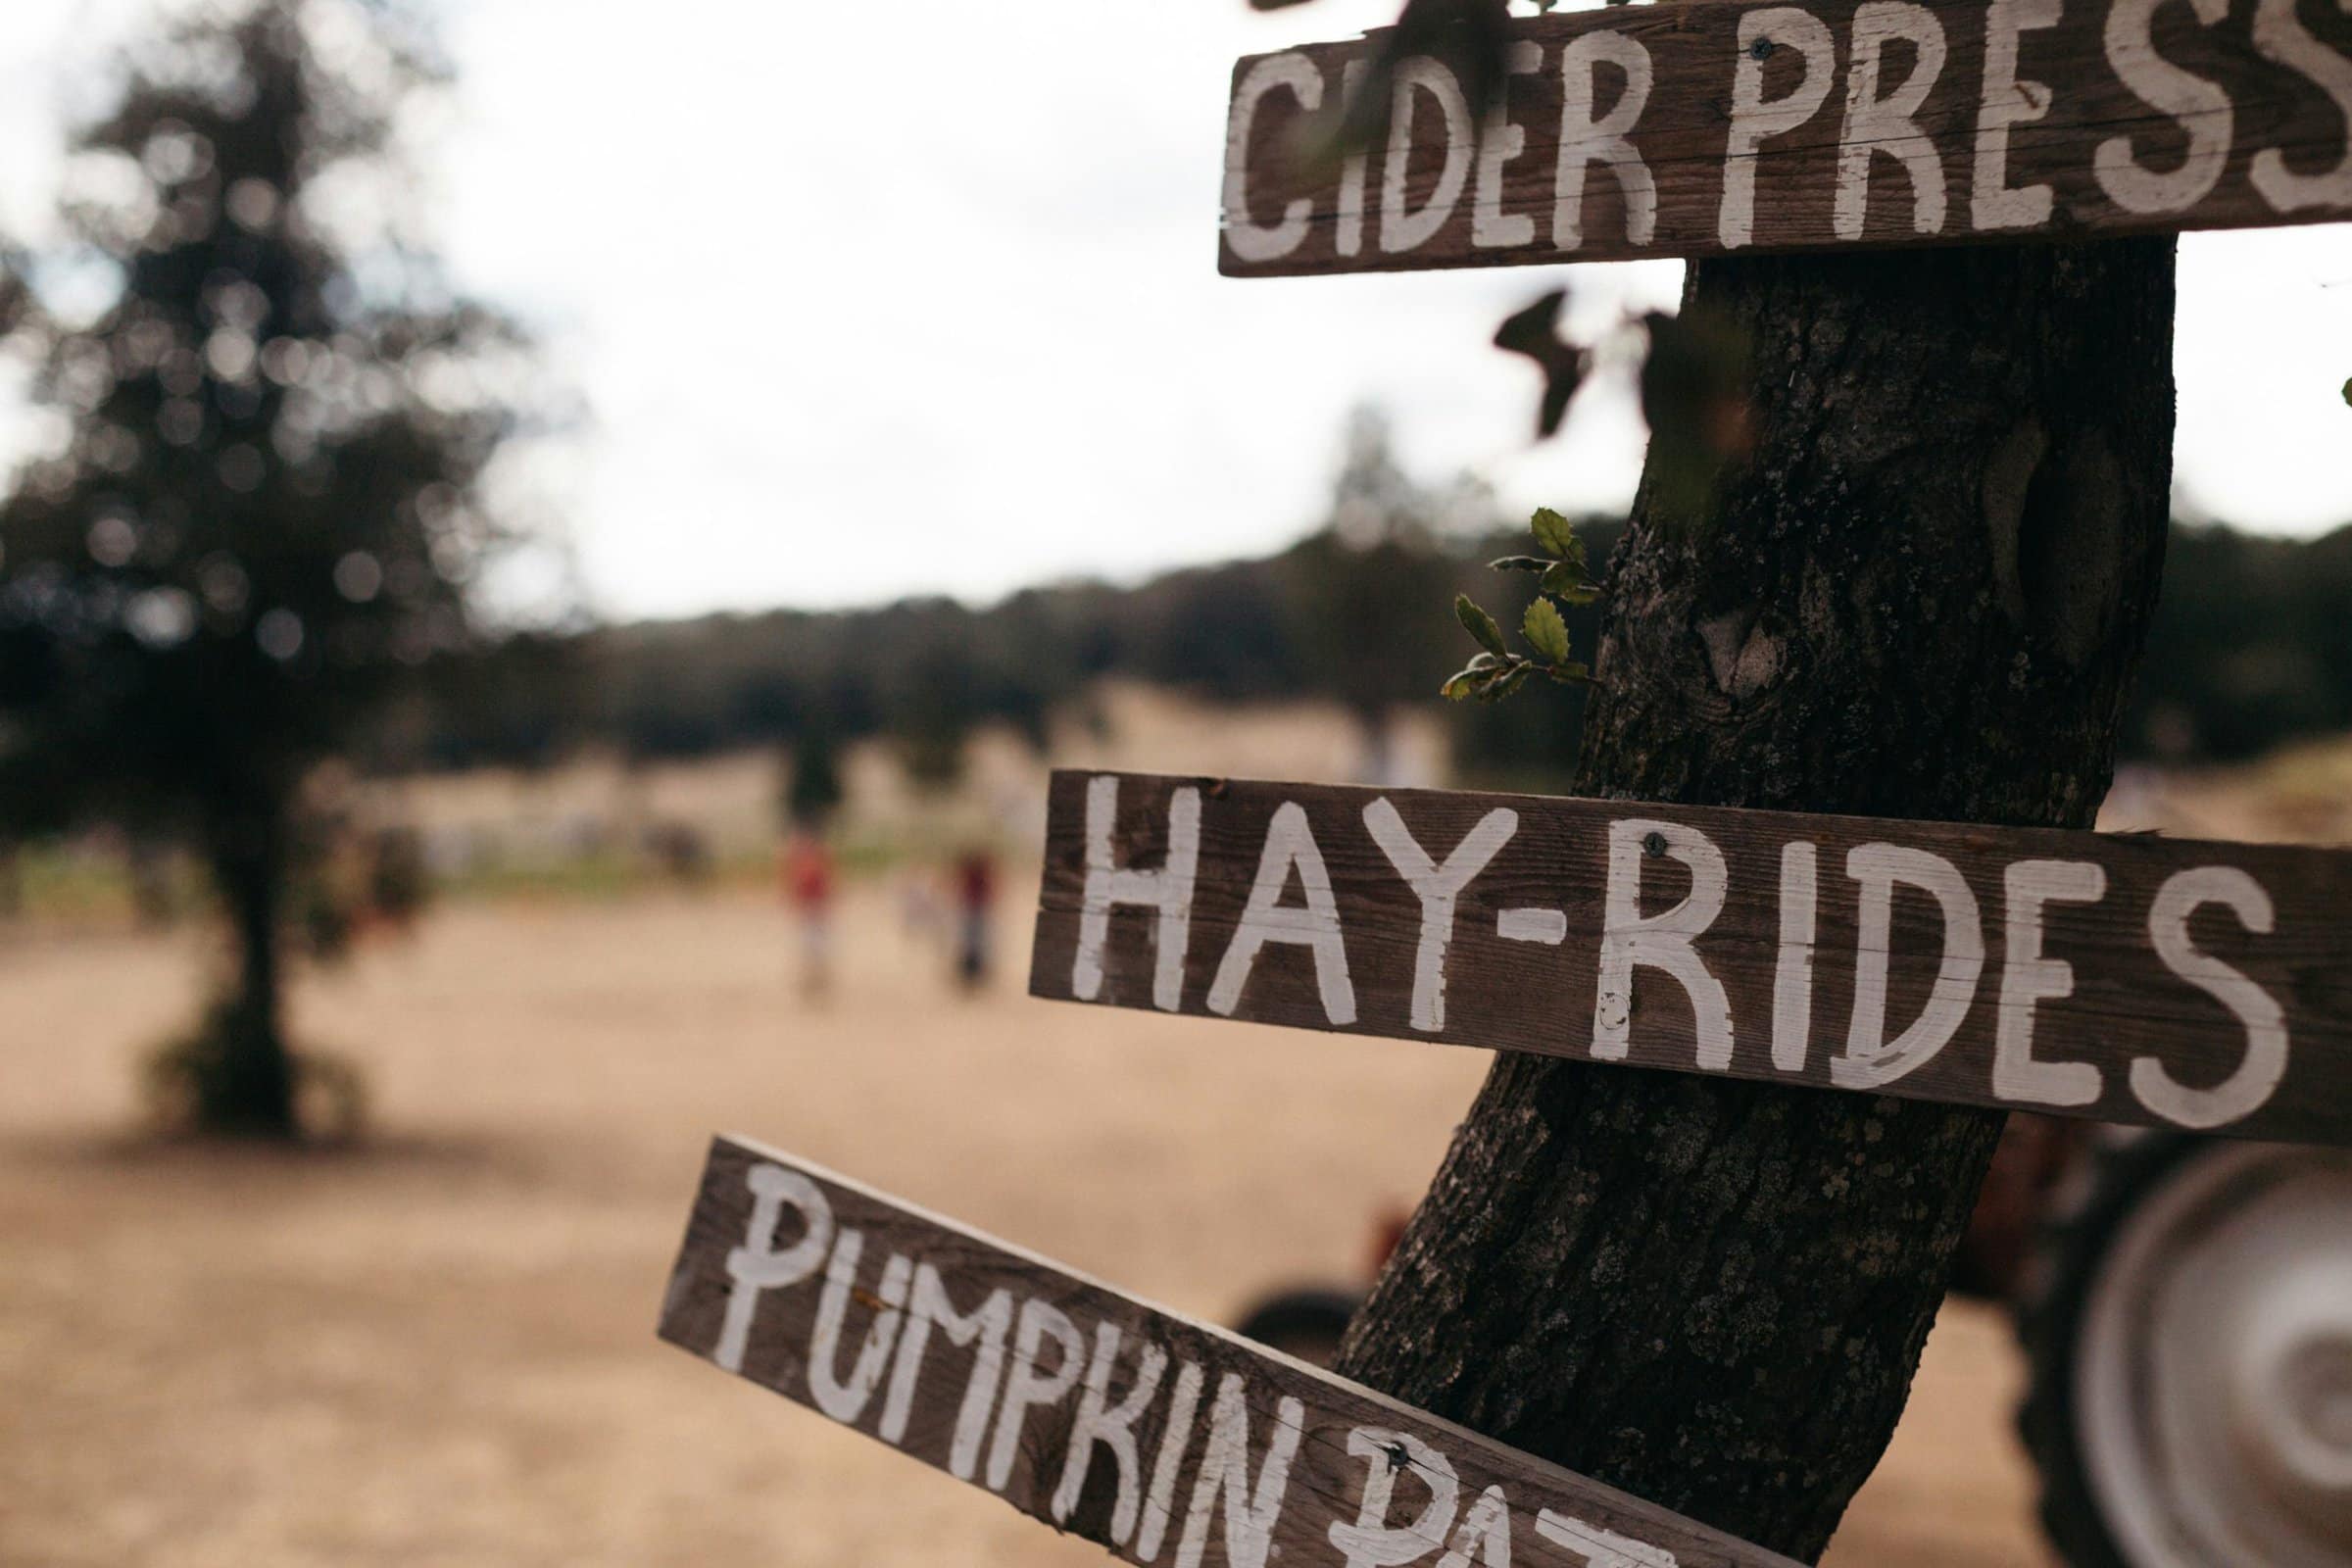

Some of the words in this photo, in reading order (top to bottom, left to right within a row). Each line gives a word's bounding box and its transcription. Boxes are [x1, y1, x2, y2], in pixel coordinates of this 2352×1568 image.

[1223, 29, 1657, 263] CIDER
[1718, 0, 2352, 249] PRESS
[1072, 775, 2289, 1129] HAY-RIDES
[715, 1162, 1304, 1568] PUMPKIN
